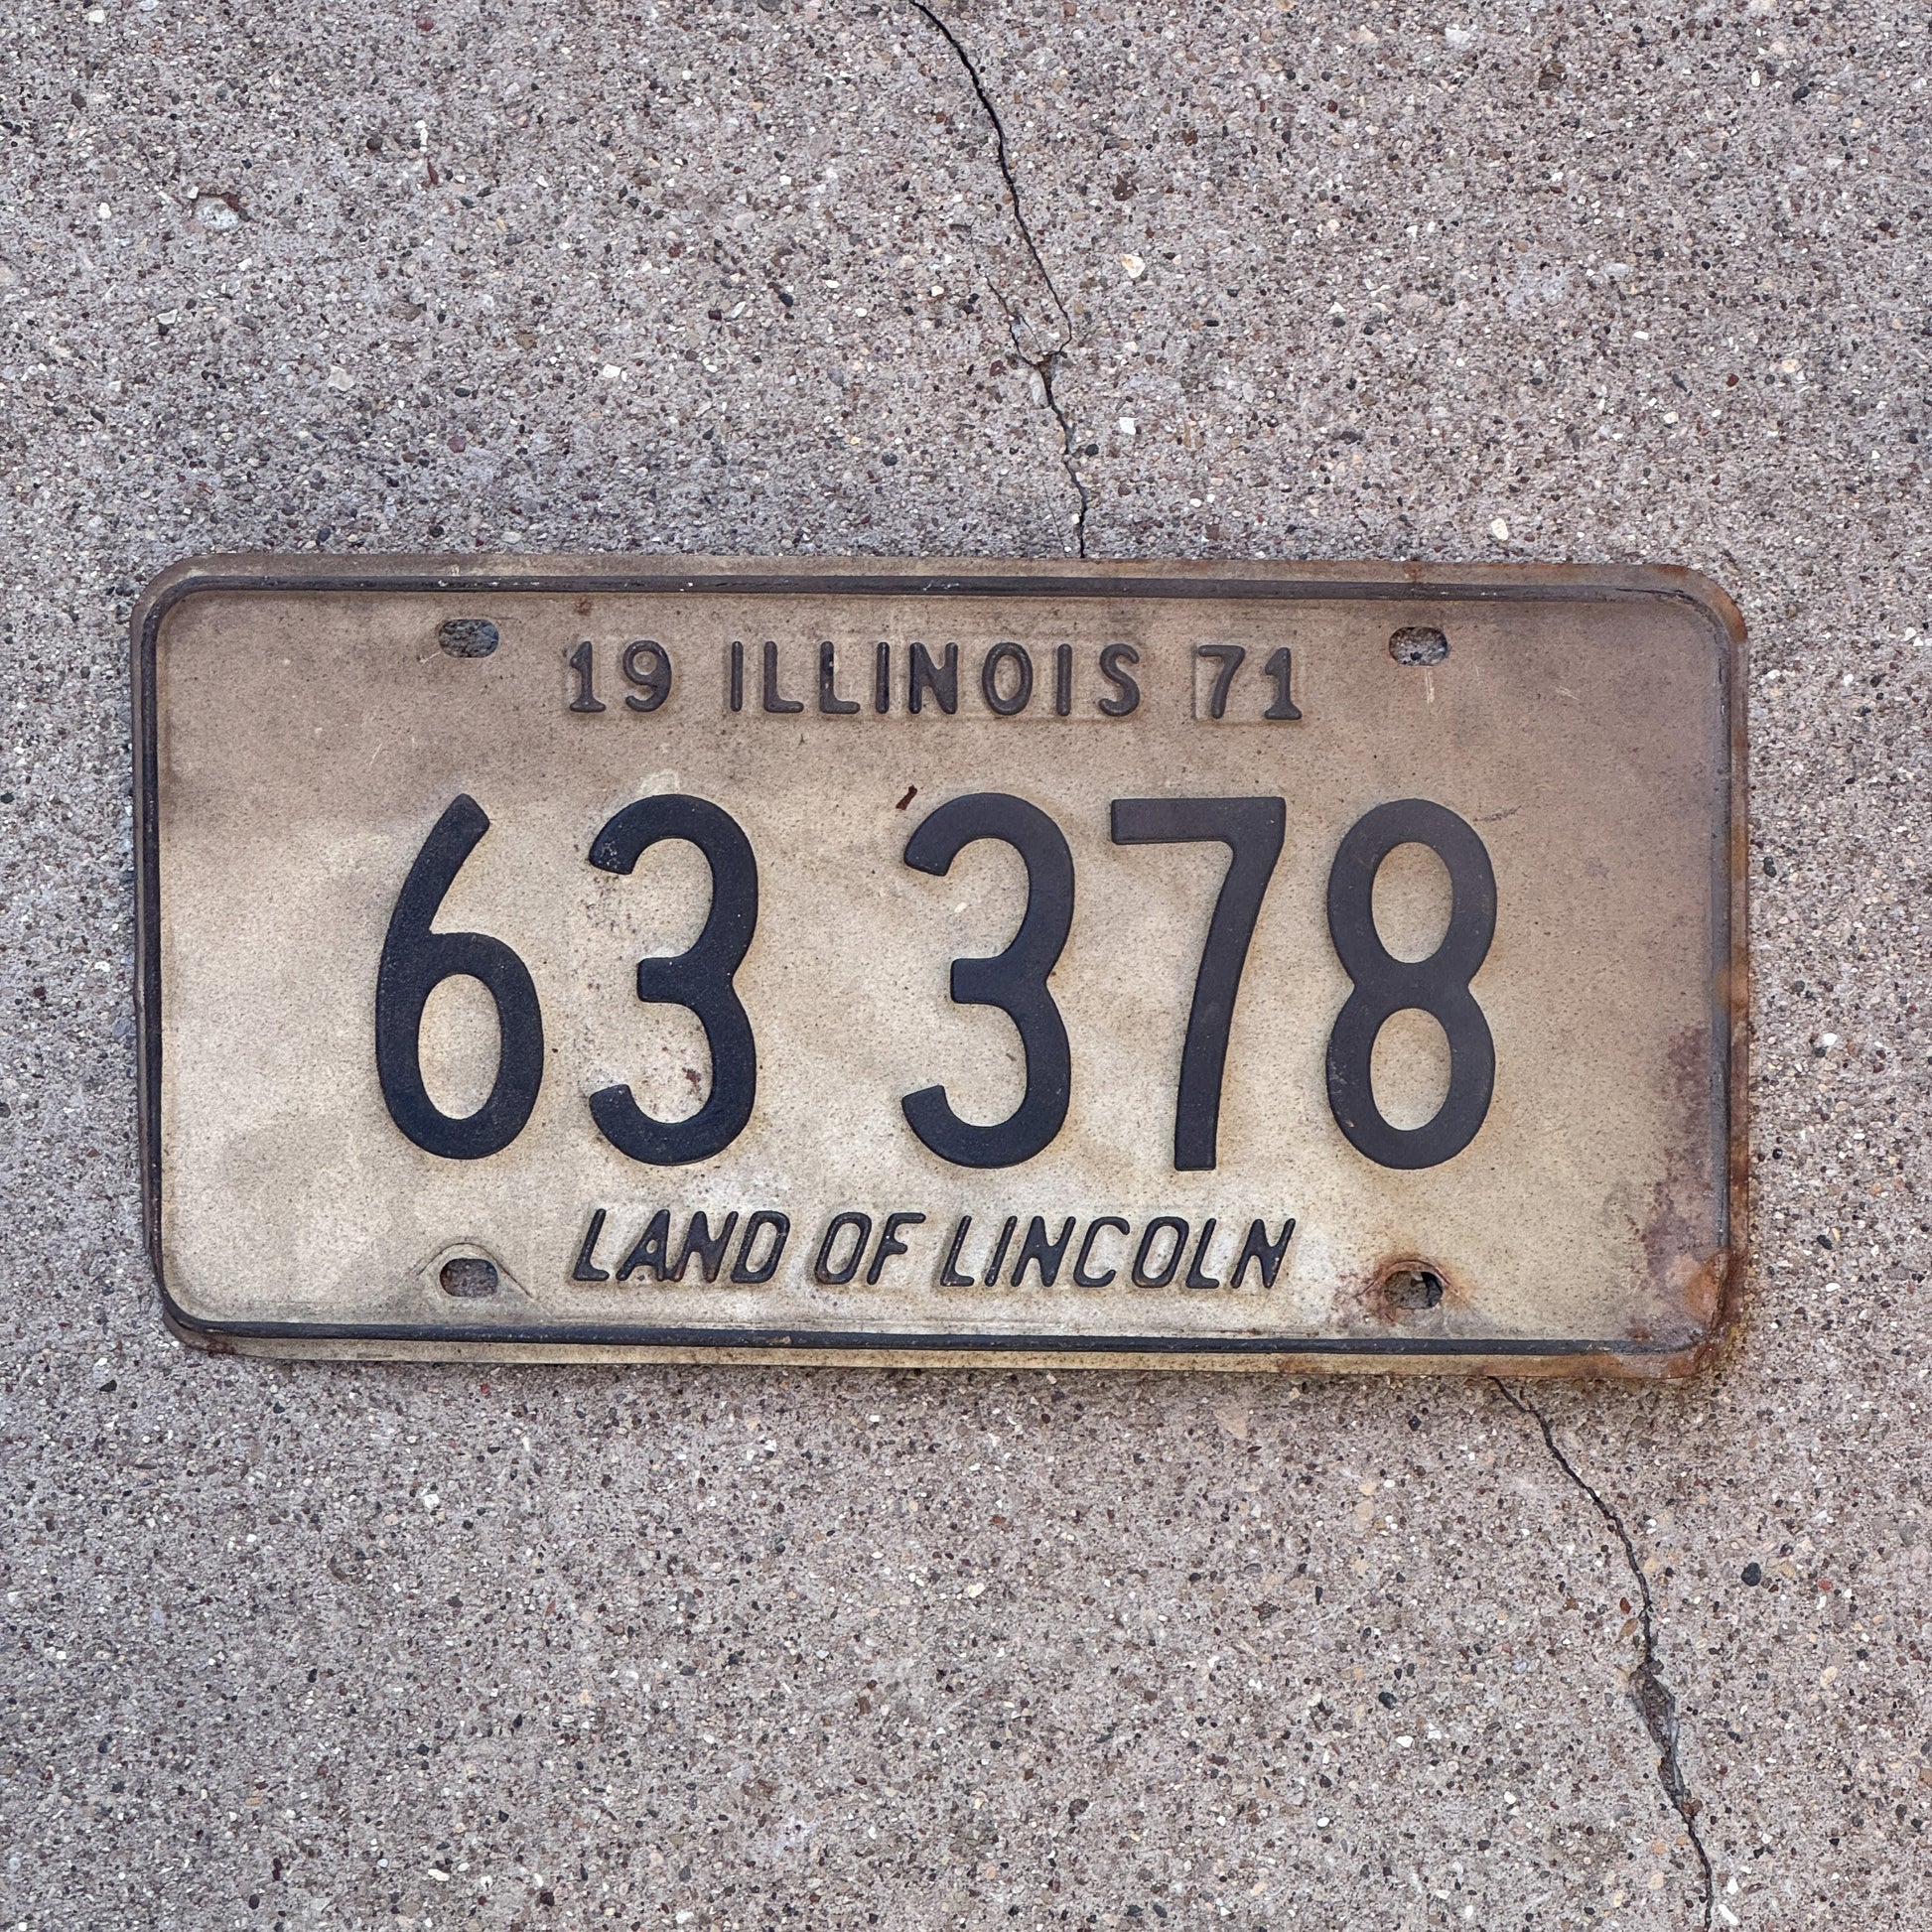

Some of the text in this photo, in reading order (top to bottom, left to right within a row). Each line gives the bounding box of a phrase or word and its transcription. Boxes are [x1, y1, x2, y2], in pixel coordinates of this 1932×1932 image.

[568, 640, 1304, 721] 19 ILLINOIS 71
[376, 792, 1497, 1172] 63 378
[574, 1207, 1298, 1290] LAND OF LINCOLN
